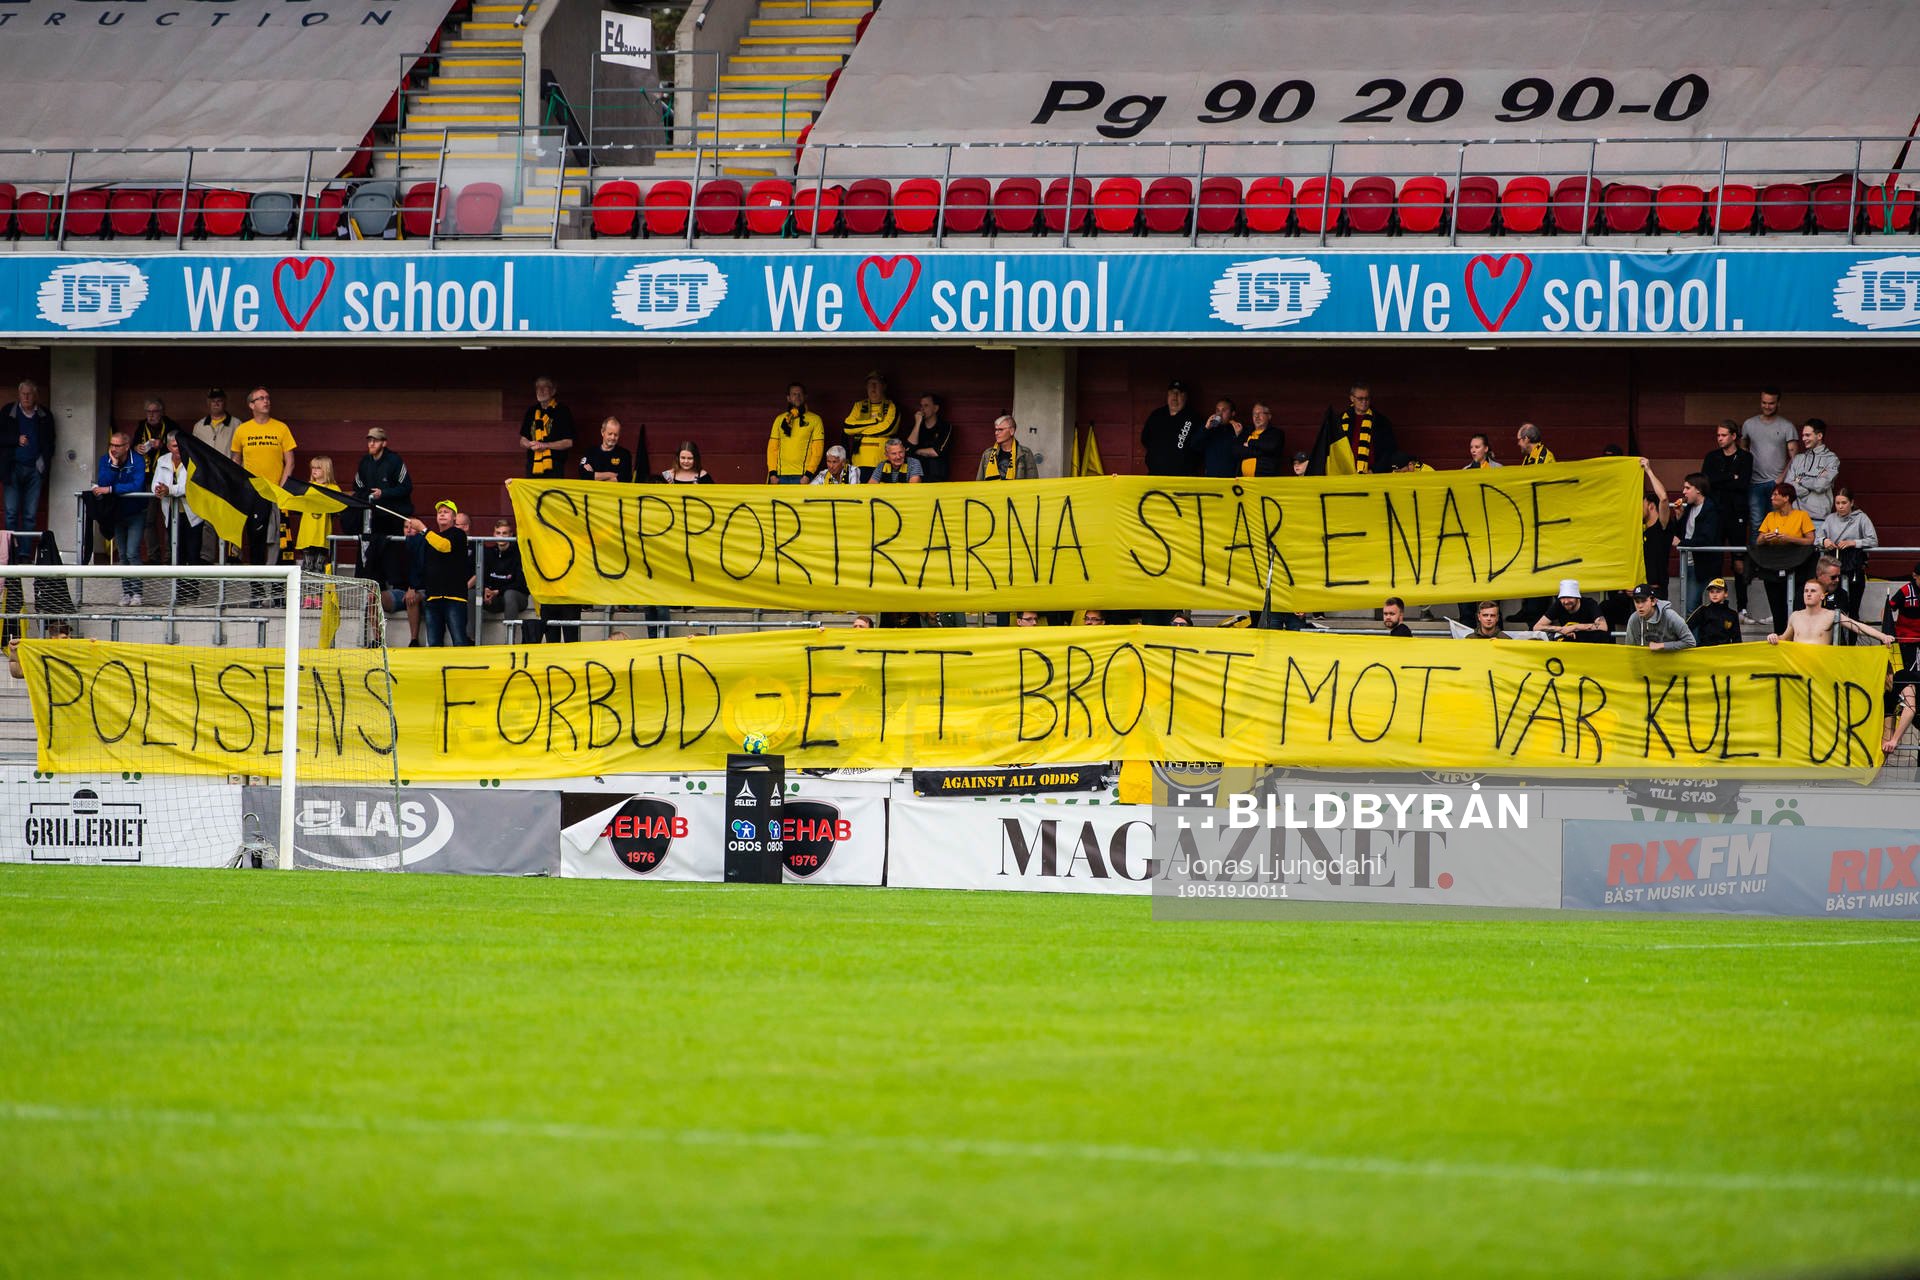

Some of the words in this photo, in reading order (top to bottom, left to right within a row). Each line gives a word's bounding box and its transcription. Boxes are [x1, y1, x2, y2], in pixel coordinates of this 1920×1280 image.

[605, 20, 624, 53] E4
[1031, 80, 1168, 137] Pg
[1197, 79, 1316, 124] 90
[1339, 77, 1464, 123] 20
[1494, 73, 1710, 123] 90-0
[61, 275, 131, 313] IST
[184, 266, 260, 331] We
[343, 261, 530, 331] school.
[637, 274, 709, 313] IST
[765, 265, 843, 331] We
[931, 261, 1124, 331] school.
[1236, 272, 1312, 313] IST
[1368, 264, 1449, 332] We
[1542, 259, 1744, 331] school.
[1177, 421, 1192, 448] adidas
[527, 488, 1089, 591] SUPPORTRARNA
[1129, 484, 1295, 589] STÅR
[1320, 479, 1583, 588] ENADE
[41, 655, 399, 758] POLISENS
[443, 652, 721, 753] FÖRBUD
[1018, 642, 1255, 742] BROTT
[1281, 655, 1461, 745] MOT
[1488, 656, 1607, 764] VÅR
[1643, 672, 1874, 768] KULTUR
[942, 775, 1006, 790] AGAINST
[1009, 773, 1036, 788] ALL
[1039, 772, 1079, 786] ODDS
[1650, 787, 1677, 801] TILL
[1681, 791, 1717, 804] STAD
[734, 799, 758, 807] SELECT
[25, 817, 148, 847] GRILLERIET
[302, 800, 427, 839] ELIAS
[784, 818, 852, 842] EHAB
[627, 852, 656, 864] 1976
[728, 841, 762, 852] OBOS
[767, 841, 784, 852] OBOS
[790, 855, 818, 867] 1976
[1604, 887, 1644, 905] BÄST
[1647, 884, 1697, 901] MUSIK
[1699, 880, 1735, 897] JUST
[1740, 879, 1767, 894] NU!
[1826, 894, 1865, 912] BÄST
[1868, 891, 1919, 909] MUSIK
